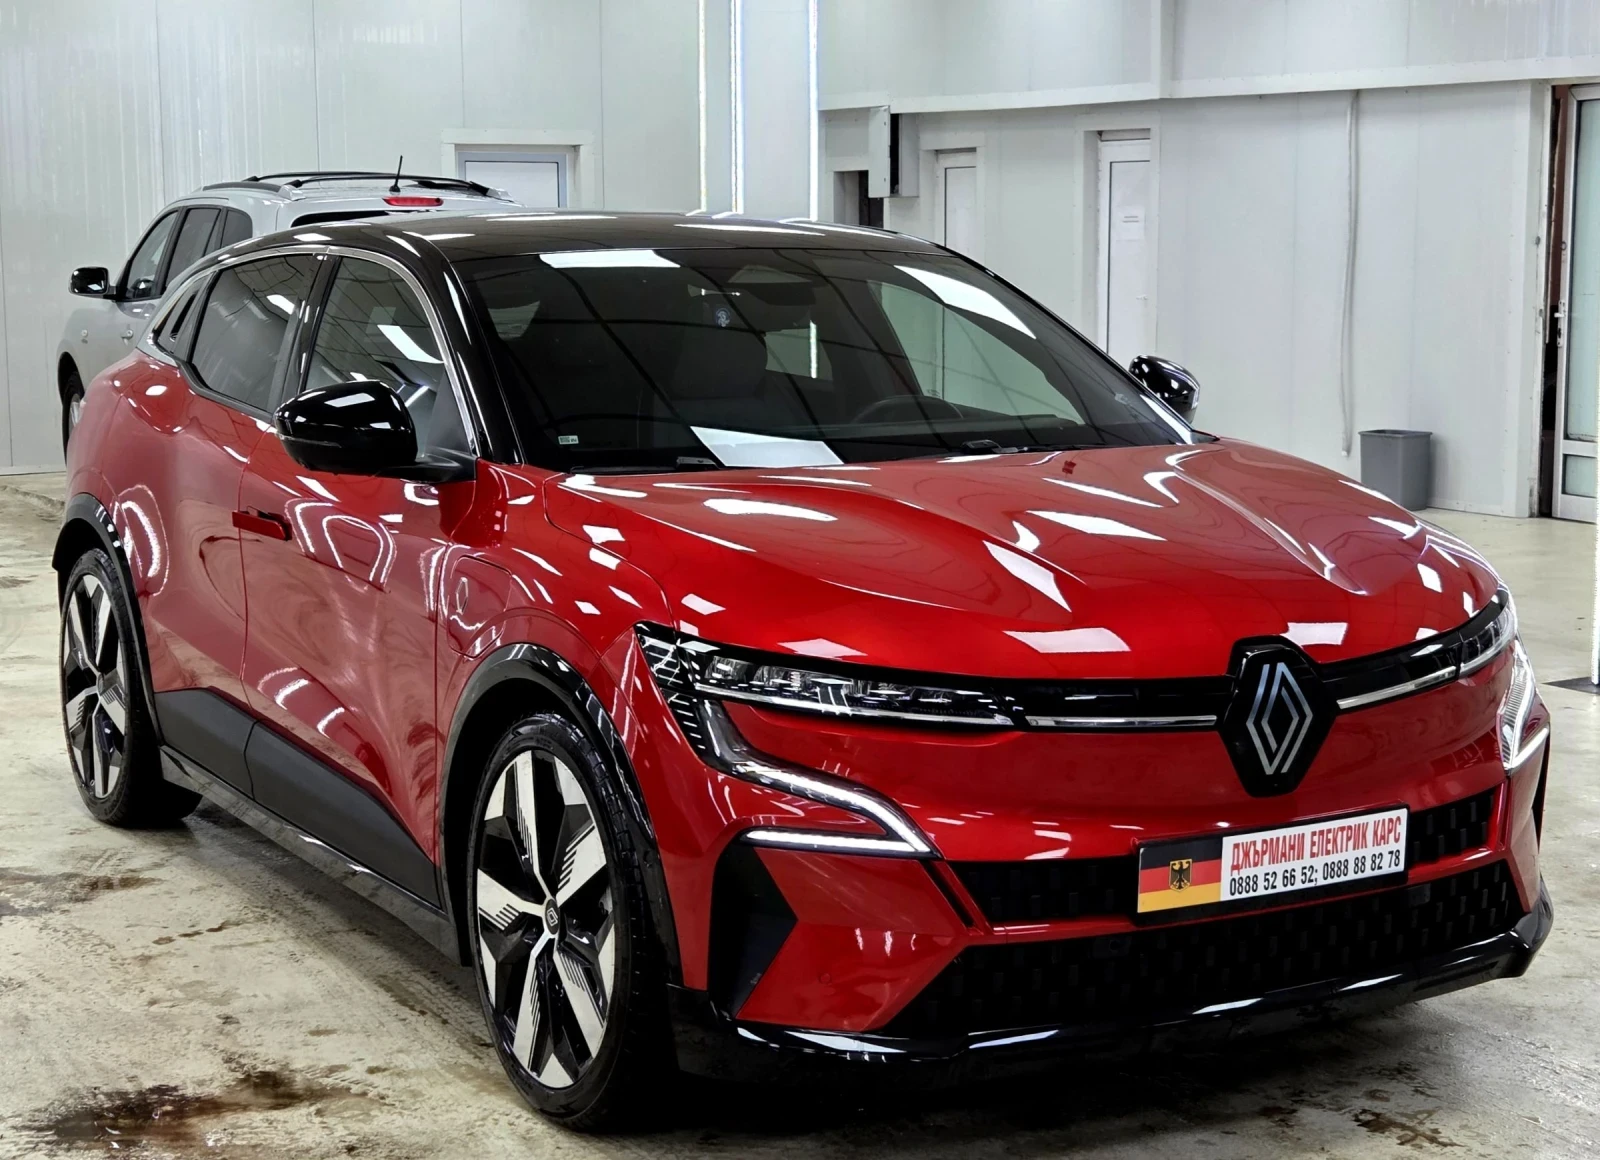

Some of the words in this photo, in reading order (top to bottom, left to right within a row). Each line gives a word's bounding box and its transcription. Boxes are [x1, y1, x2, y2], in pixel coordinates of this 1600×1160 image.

[1229, 875, 1258, 896] 0888
[1263, 871, 1277, 891] 52
[1282, 868, 1296, 888] 66
[1301, 865, 1318, 885] 52;
[1322, 859, 1349, 881] 0888
[1353, 856, 1366, 874] 88
[1370, 852, 1383, 871] 82
[1388, 849, 1400, 867] 78
[1231, 832, 1304, 876] ДЖЪРМАНИ
[1309, 821, 1369, 858] ЕЛЕКТРИК
[1372, 815, 1401, 847] КАРС
